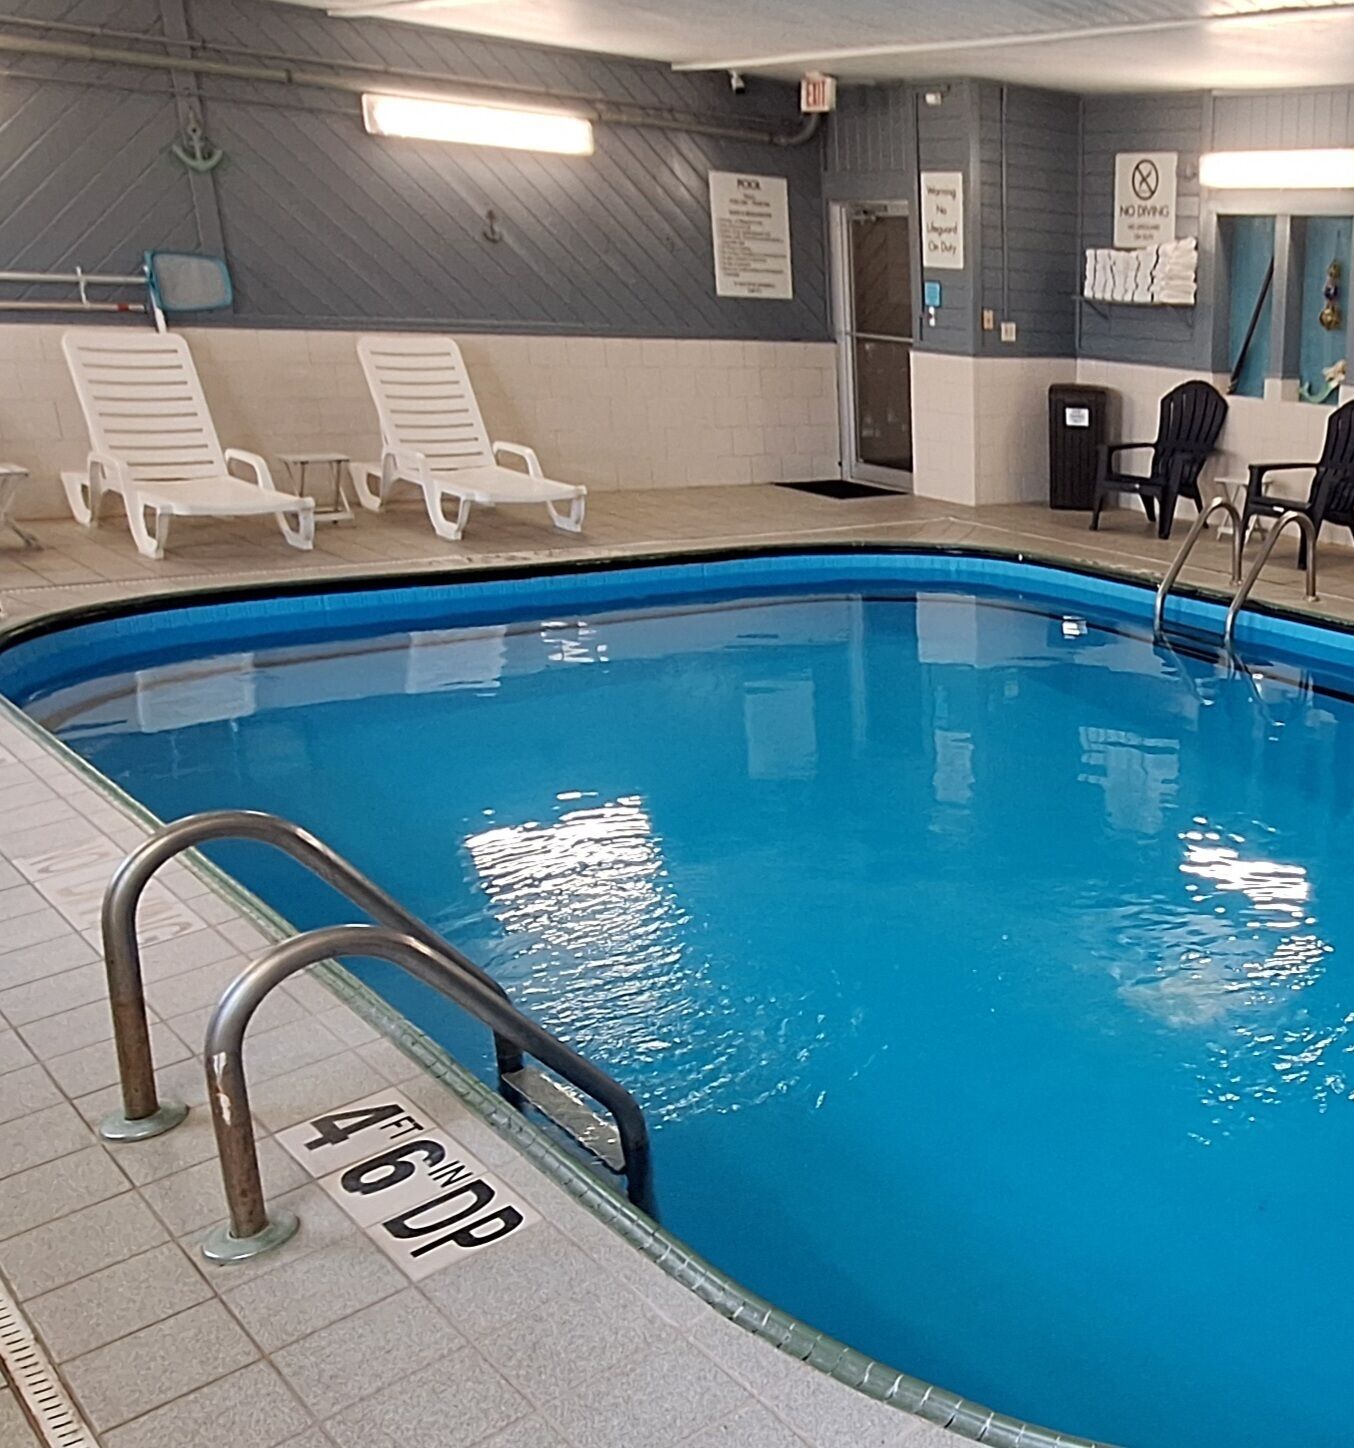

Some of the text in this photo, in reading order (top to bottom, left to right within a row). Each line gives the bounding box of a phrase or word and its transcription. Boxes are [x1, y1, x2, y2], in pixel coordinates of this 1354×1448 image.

[805, 79, 827, 107] EXIT
[926, 187, 957, 200] Warning
[935, 205, 947, 215] No
[1120, 204, 1170, 217] NO DIVING
[926, 221, 957, 237] Lifeguard
[928, 240, 957, 255] On Duty
[381, 1178, 524, 1259] DP
